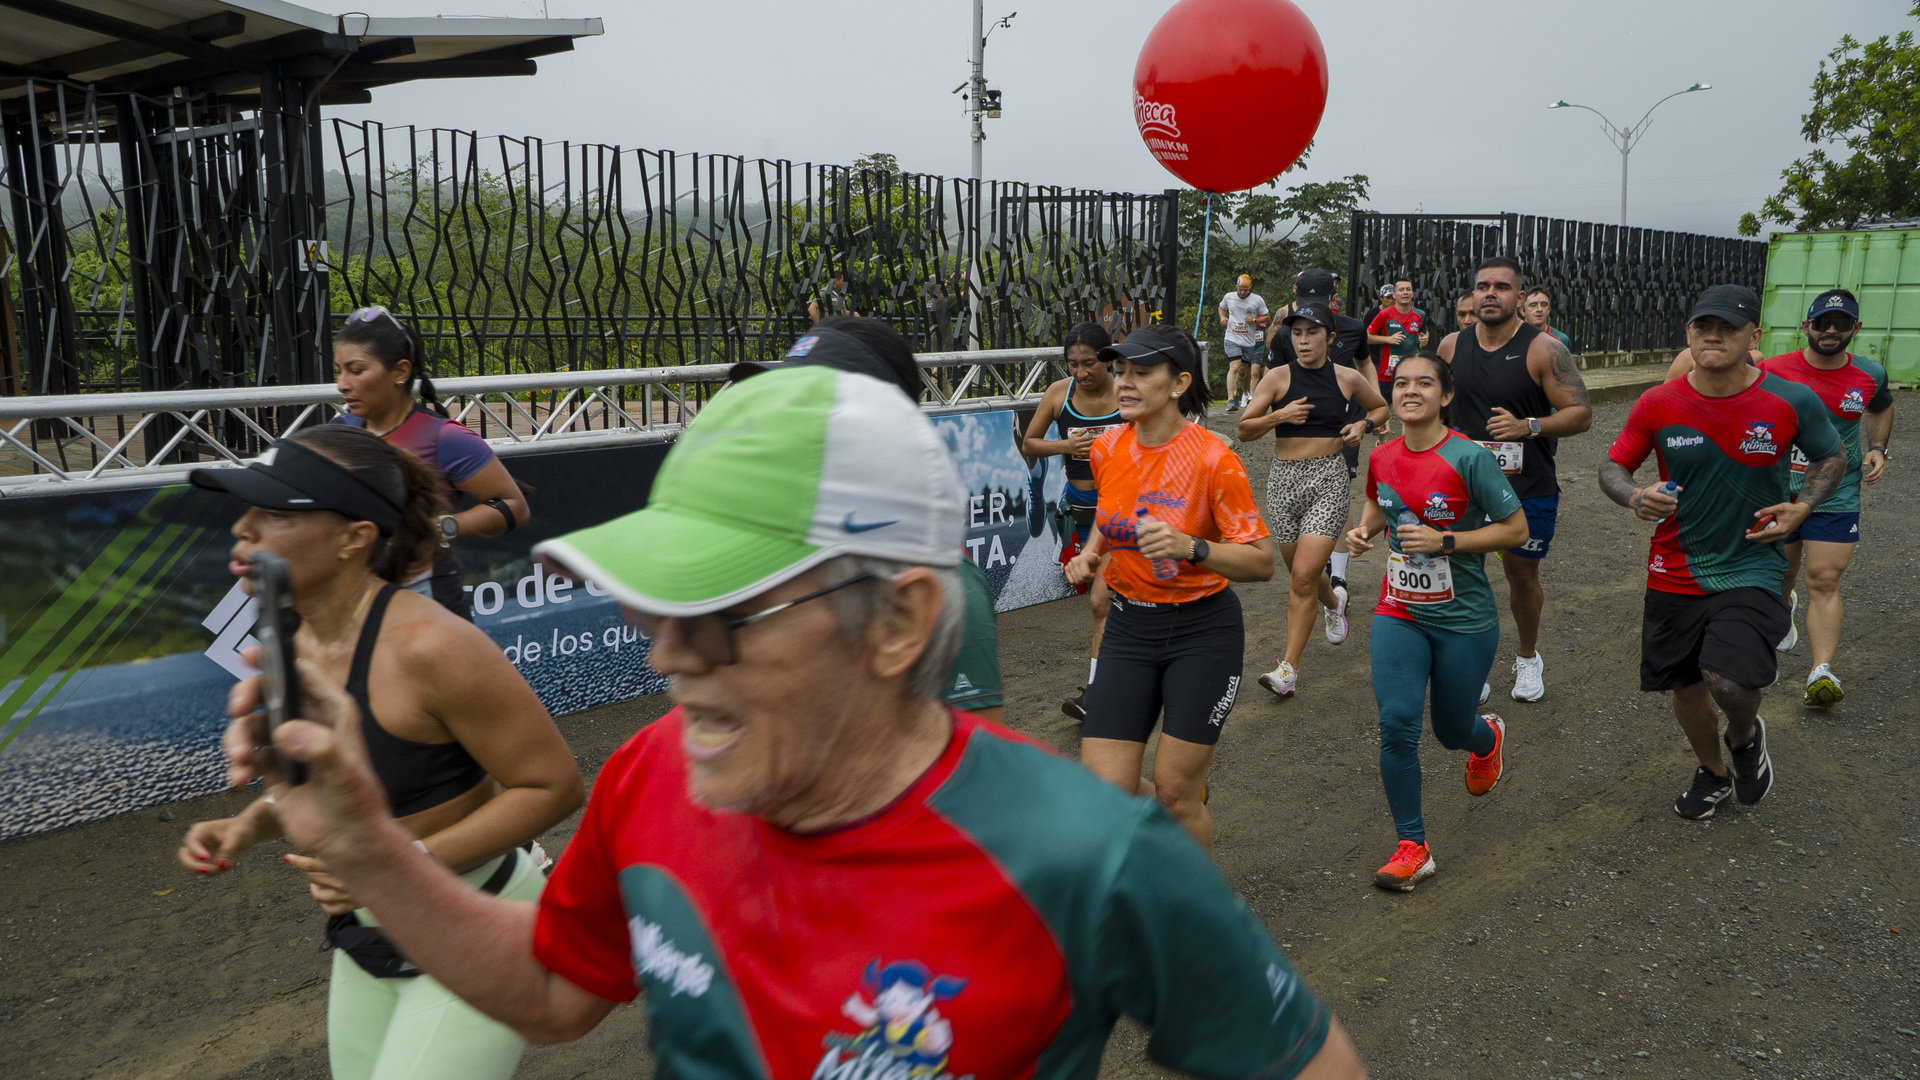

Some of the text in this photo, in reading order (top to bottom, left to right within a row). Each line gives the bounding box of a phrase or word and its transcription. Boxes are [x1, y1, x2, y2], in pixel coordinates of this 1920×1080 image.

[1495, 454, 1507, 467] 6
[963, 492, 1014, 528] ER,
[463, 581, 504, 616] o
[517, 562, 573, 609] de
[1399, 570, 1431, 590] 900
[504, 634, 541, 665] de
[551, 628, 593, 657] los
